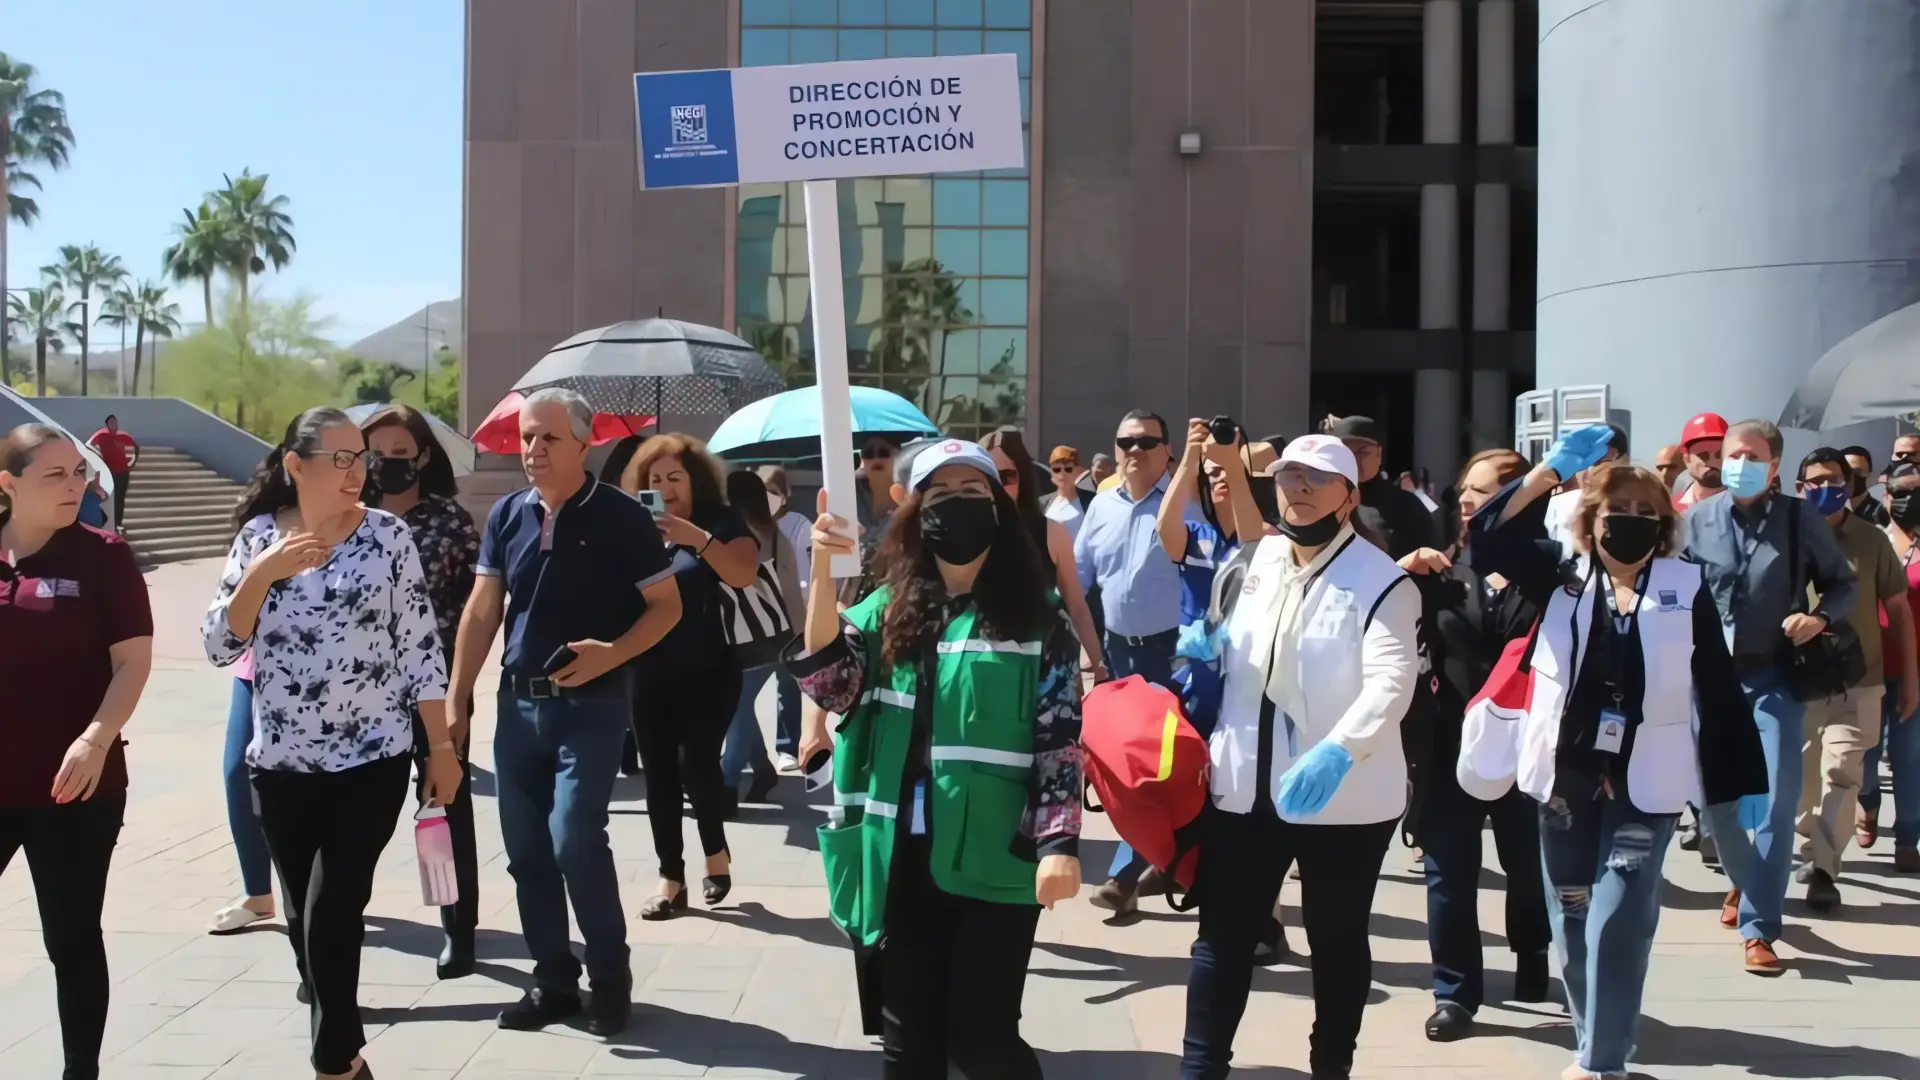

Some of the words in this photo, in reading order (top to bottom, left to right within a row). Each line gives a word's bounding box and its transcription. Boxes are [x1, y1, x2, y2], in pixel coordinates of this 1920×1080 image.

[788, 75, 922, 104] DIRECCIÓN
[930, 77, 962, 97] DE
[793, 101, 940, 132] PROMOCIÓN
[947, 104, 962, 123] Y
[784, 127, 974, 161] CONCERTACIÓN
